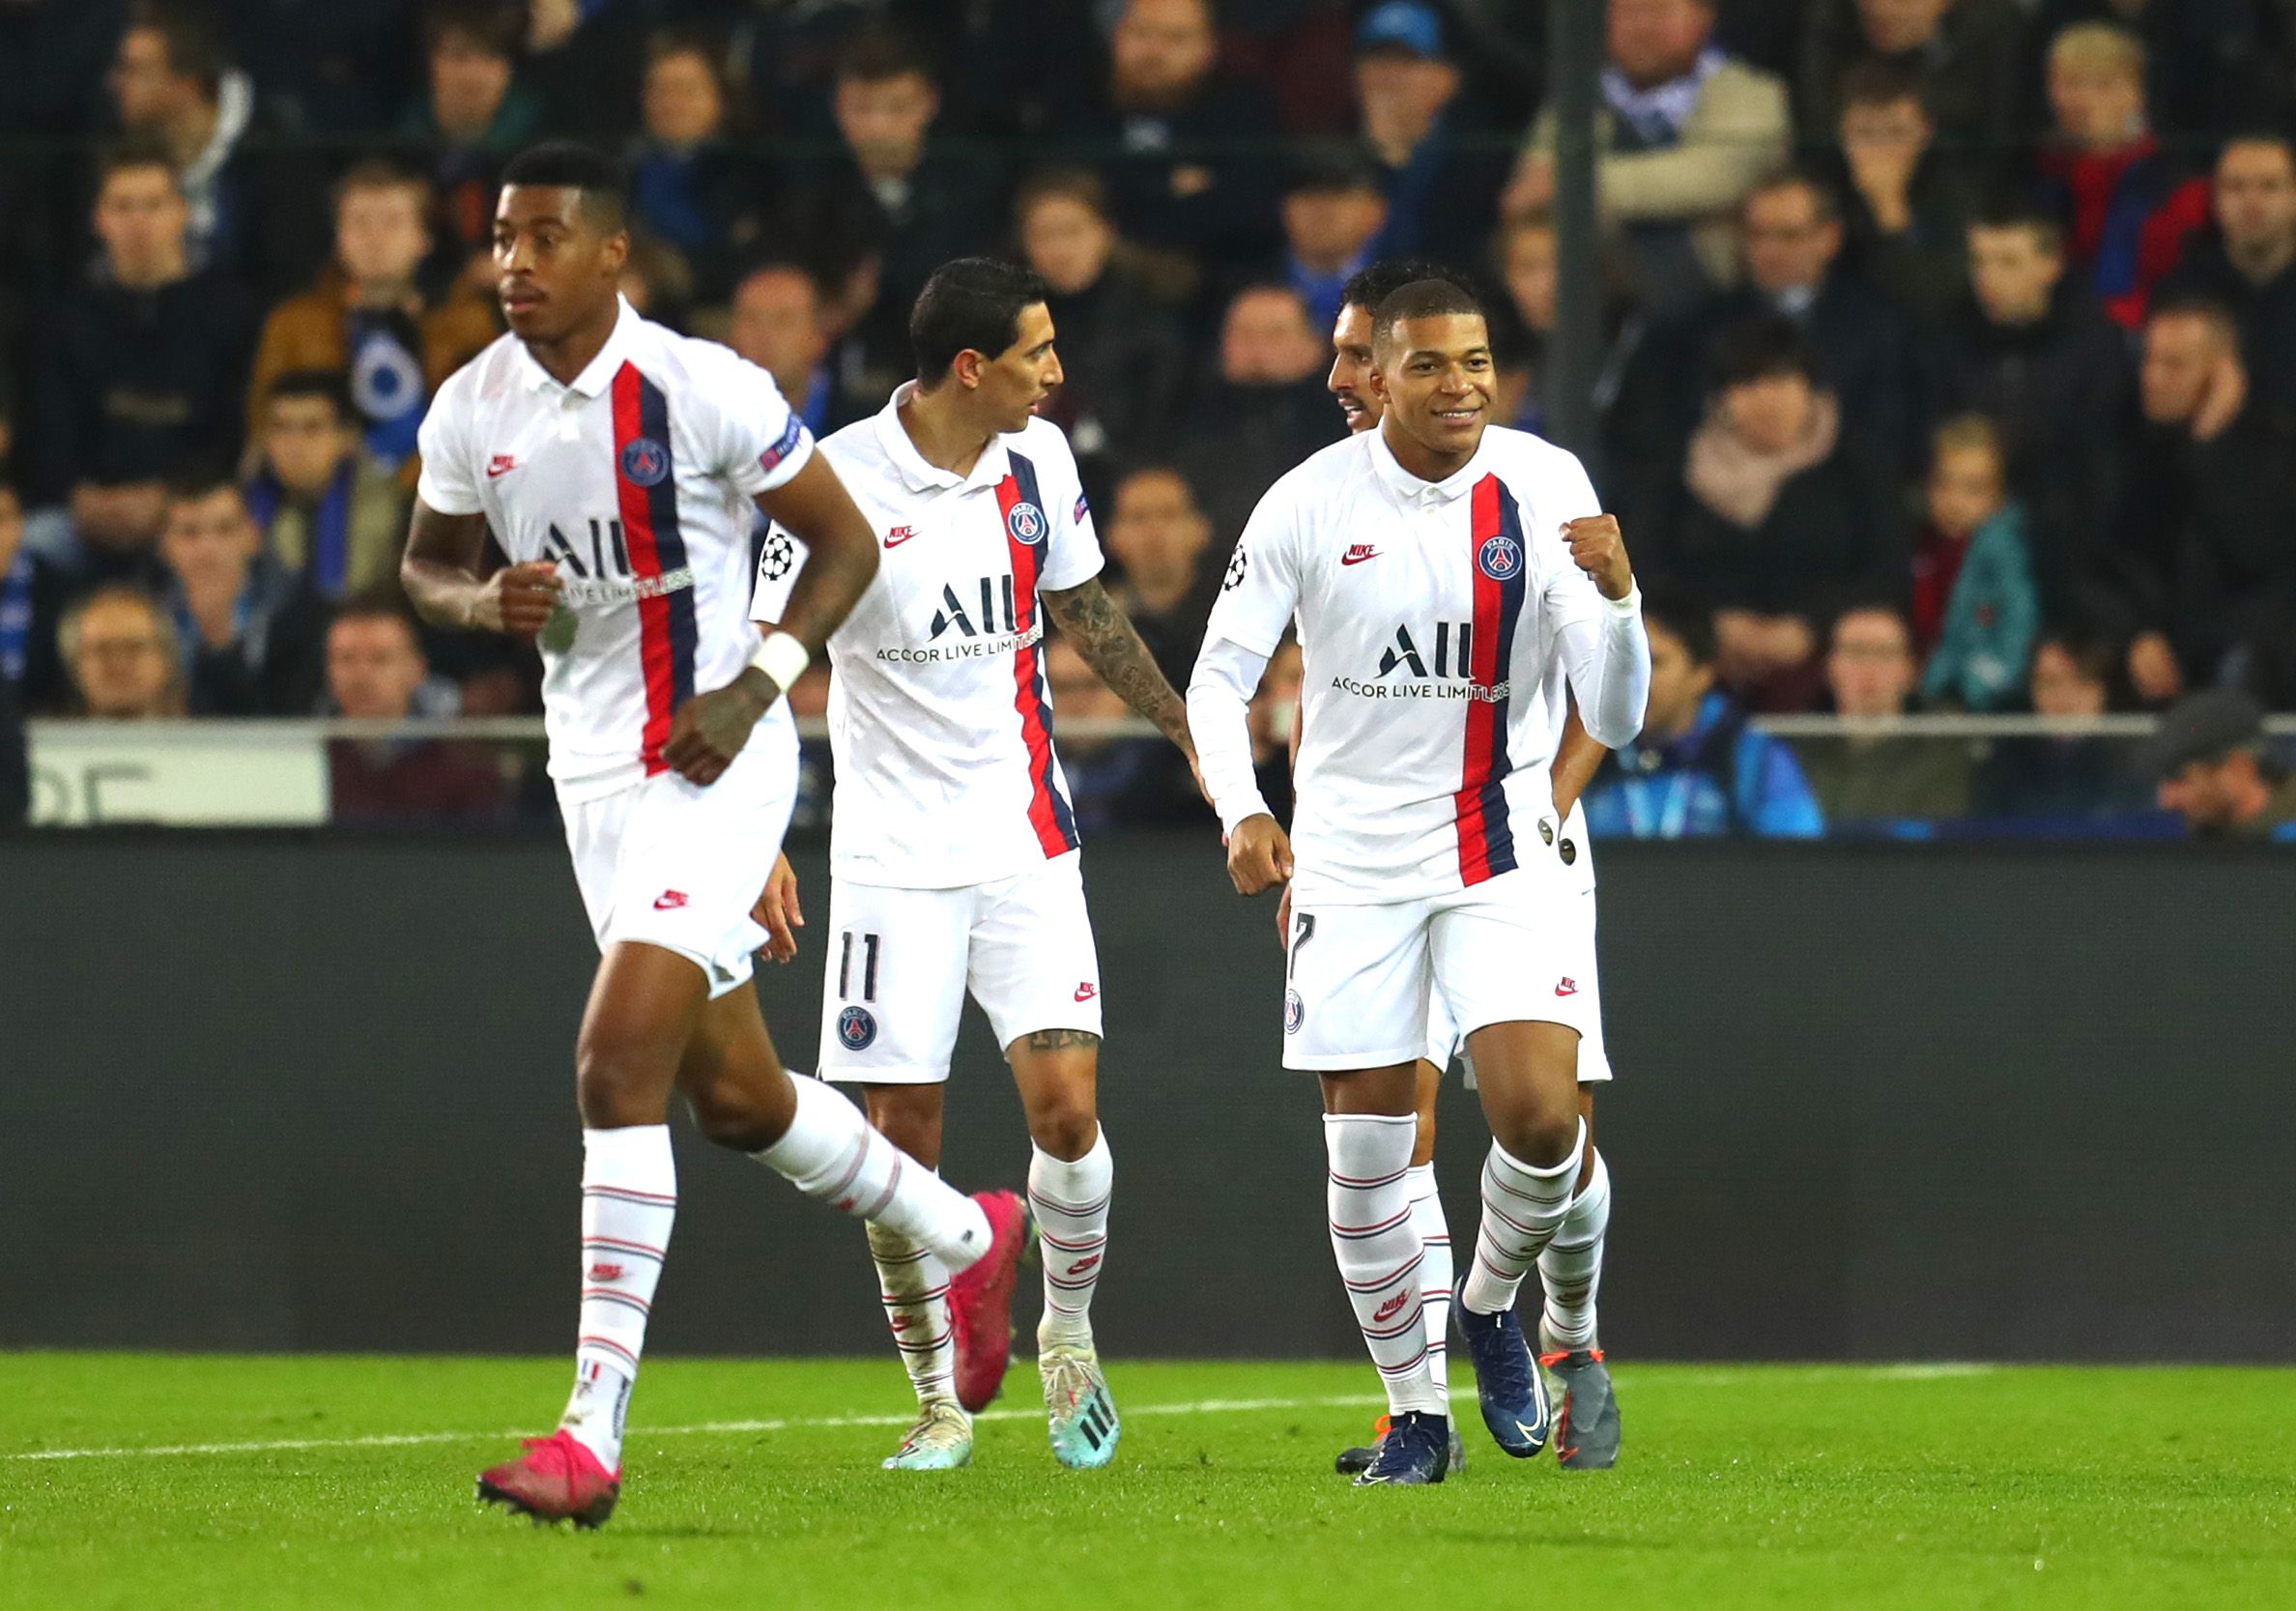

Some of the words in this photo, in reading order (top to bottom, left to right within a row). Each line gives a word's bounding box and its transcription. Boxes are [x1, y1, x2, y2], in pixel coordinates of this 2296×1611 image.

[1486, 538, 1514, 550] PARIS
[876, 648, 940, 663] ACCOR
[945, 644, 982, 660] LIVE
[1332, 676, 1388, 699] ACCOR
[1392, 684, 1432, 699] LIVE
[1437, 680, 1511, 704] LIMITLESS
[1288, 911, 1315, 980] 7
[839, 931, 878, 1002] 11
